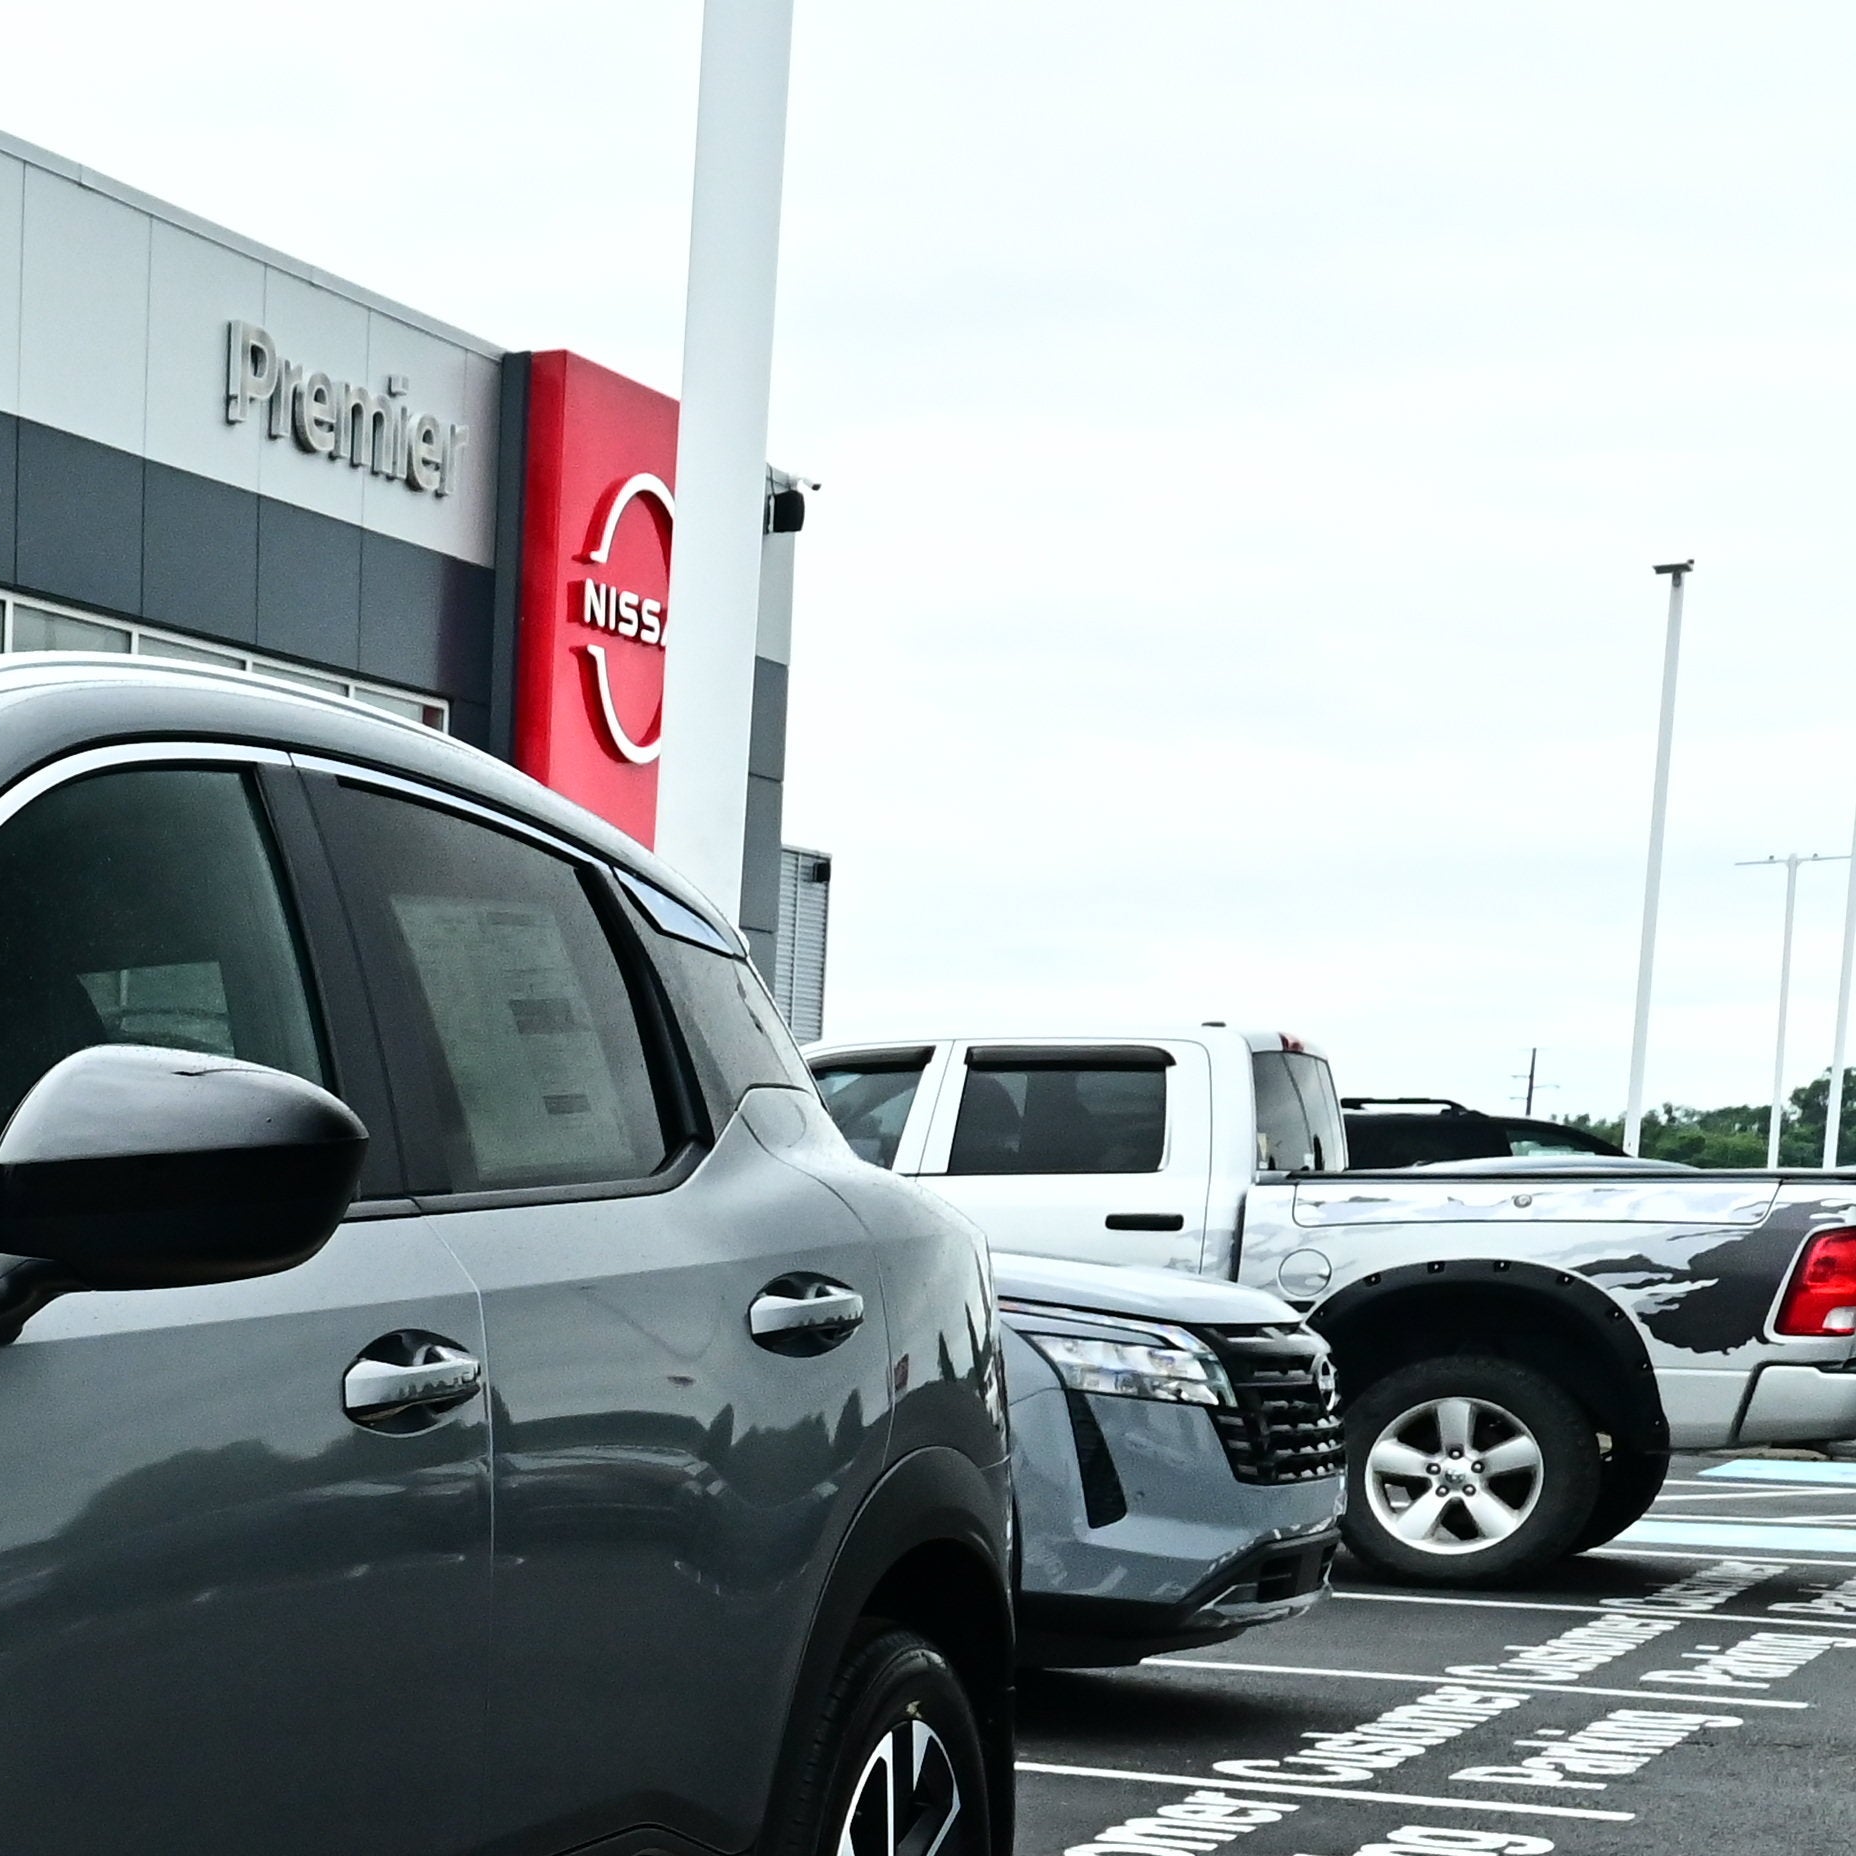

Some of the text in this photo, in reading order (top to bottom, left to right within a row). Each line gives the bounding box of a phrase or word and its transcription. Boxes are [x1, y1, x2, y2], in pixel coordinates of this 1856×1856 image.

[225, 319, 470, 498] Premier
[584, 577, 668, 647] NISS
[1445, 1614, 1681, 1681] Customer
[1213, 1685, 1531, 1782] Customer
[1449, 1707, 1744, 1791] Parking
